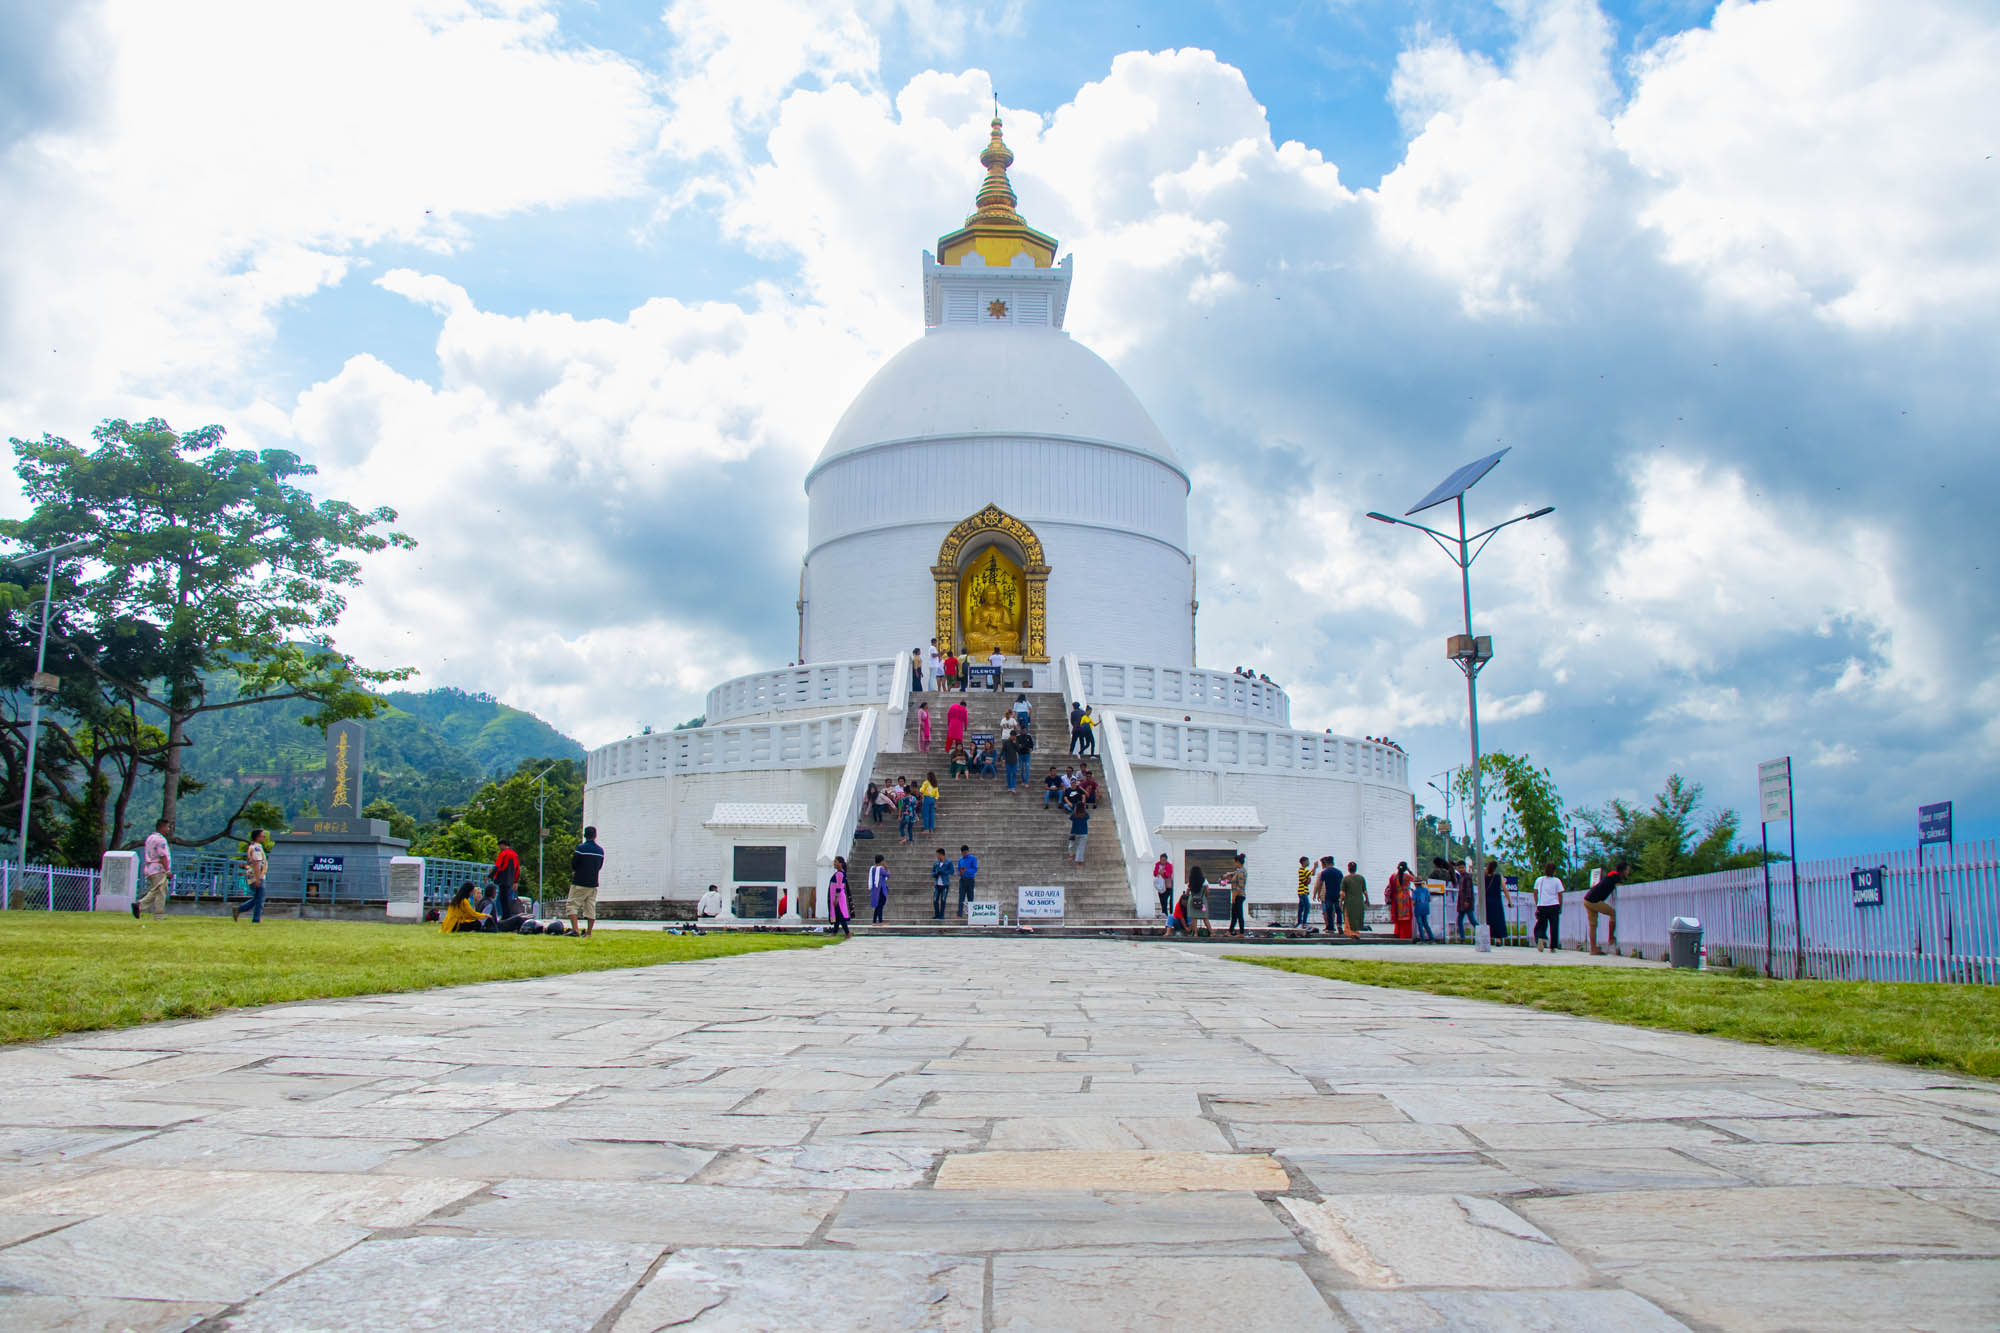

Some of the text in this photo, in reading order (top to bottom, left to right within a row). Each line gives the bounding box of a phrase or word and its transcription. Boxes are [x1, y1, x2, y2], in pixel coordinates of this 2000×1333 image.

[312, 863, 343, 871] JUMPING
[1858, 873, 1872, 887] NO
[1853, 888, 1880, 903] JUMPING
